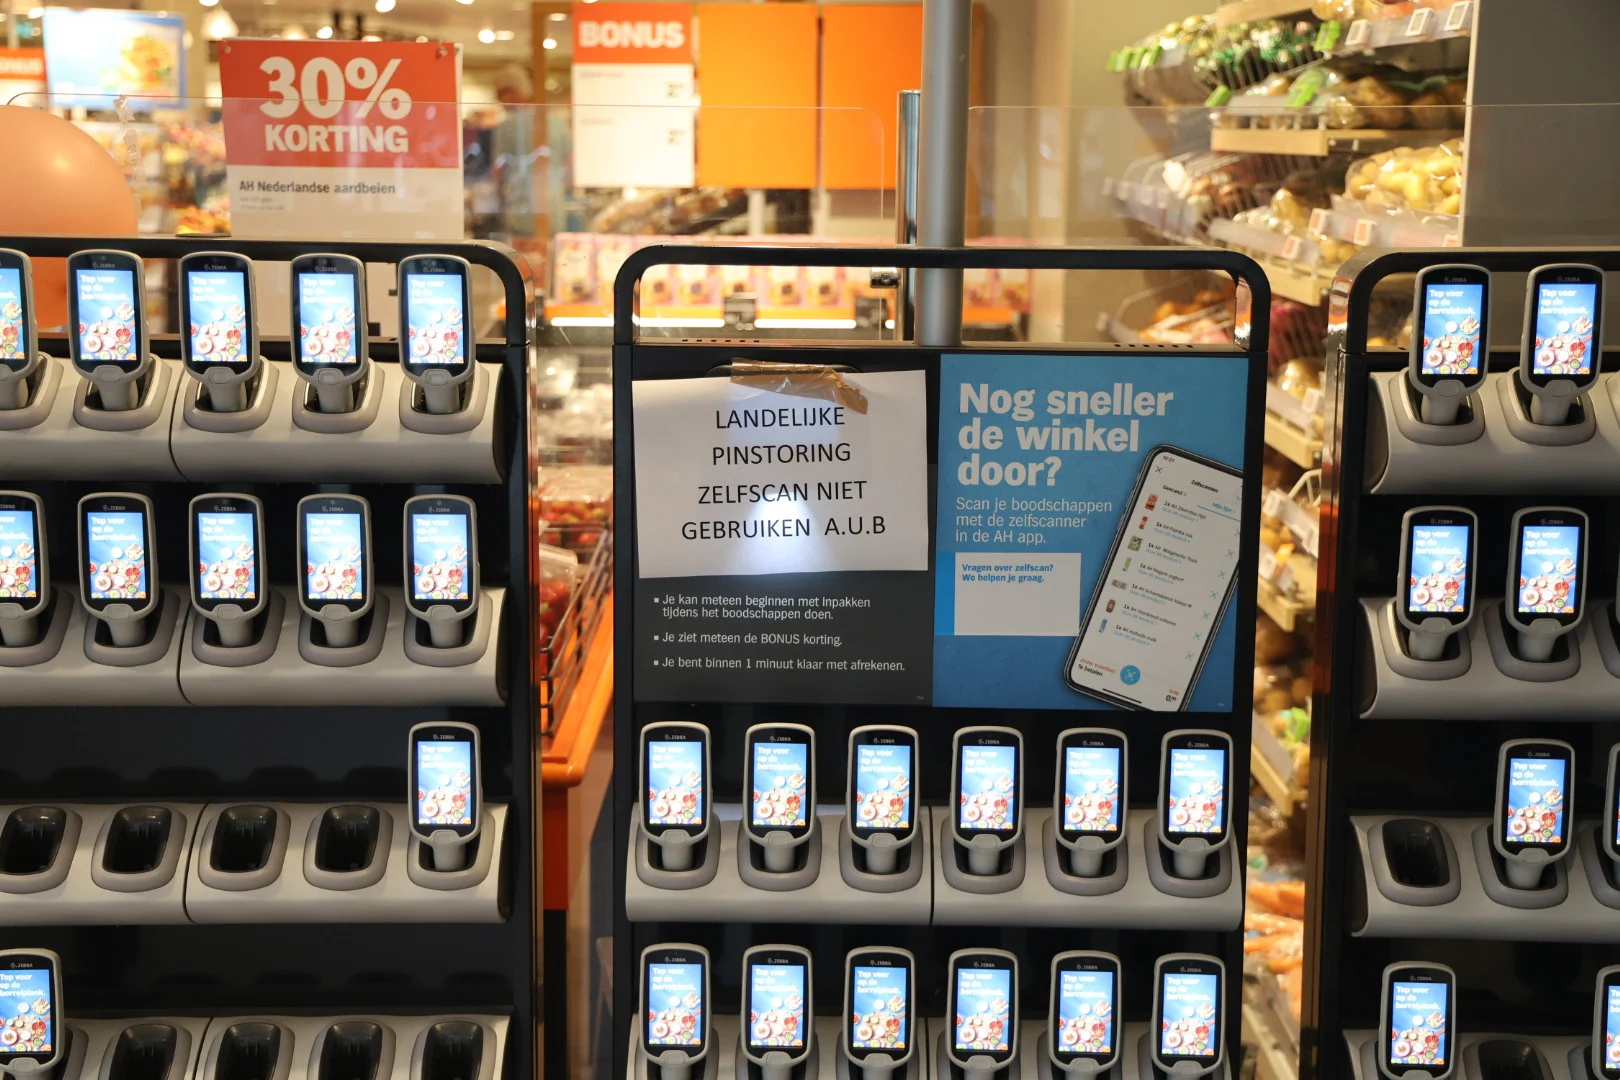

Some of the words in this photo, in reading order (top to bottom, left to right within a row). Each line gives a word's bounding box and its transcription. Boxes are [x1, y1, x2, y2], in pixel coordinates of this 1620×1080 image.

[579, 21, 685, 48] BONUS
[259, 56, 412, 120] 30%
[265, 124, 409, 153] KORTING
[240, 181, 254, 192] AH
[258, 182, 330, 193] Nederlandse
[334, 182, 396, 194] aardbeien
[1429, 289, 1444, 298] Top
[959, 383, 1035, 422] Nog
[1047, 383, 1174, 416] sneller
[716, 407, 845, 428] LANDELIJKE
[958, 418, 1003, 450] de
[1016, 418, 1139, 452] winkel
[713, 443, 851, 465] PINSTORING
[957, 453, 1062, 486] door?
[698, 483, 808, 504] ZELFSCAN
[817, 480, 867, 500] NIET
[956, 498, 990, 511] Scan
[994, 498, 1006, 514] je
[1012, 499, 1112, 514] boodschappen
[682, 518, 810, 540] GEBRUIKEN
[824, 516, 886, 536] A.U.B
[956, 514, 982, 527] met
[987, 514, 1004, 527] de
[1009, 514, 1086, 528] zelfscanner
[956, 530, 968, 542] in
[972, 530, 990, 542] de
[994, 531, 1013, 543] AH
[1018, 532, 1046, 546] app.
[962, 564, 992, 573] Vragen
[994, 564, 1013, 572] over
[1015, 563, 1054, 572] zelfscan?
[978, 574, 1006, 583] helpen
[1008, 574, 1016, 583] je
[1018, 574, 1045, 583] graag.
[662, 594, 675, 604] Je
[679, 594, 698, 605] kan
[702, 596, 742, 606] meteen
[745, 596, 794, 608] beginnen
[798, 597, 820, 607] met
[823, 596, 870, 608] inpakken
[663, 607, 698, 618] tijdens
[702, 608, 719, 618] het
[722, 608, 800, 620] boodschappen
[804, 608, 834, 620] doen.
[662, 632, 675, 643] Je
[678, 632, 697, 643] ziet
[700, 633, 741, 644] meteen
[744, 633, 758, 644] de
[761, 634, 800, 644] BONUS
[804, 634, 842, 646] korting.
[662, 657, 675, 667] Je
[678, 658, 702, 668] bent
[706, 658, 742, 668] binnen
[746, 659, 751, 668] 1
[756, 659, 793, 669] minuut
[797, 660, 822, 670] klaar
[826, 660, 847, 670] met
[850, 660, 905, 671] afrekenen.
[1084, 666, 1103, 677] betalen
[1512, 762, 1528, 771] Top
[857, 970, 872, 979] Top
[1396, 986, 1410, 994] Top
